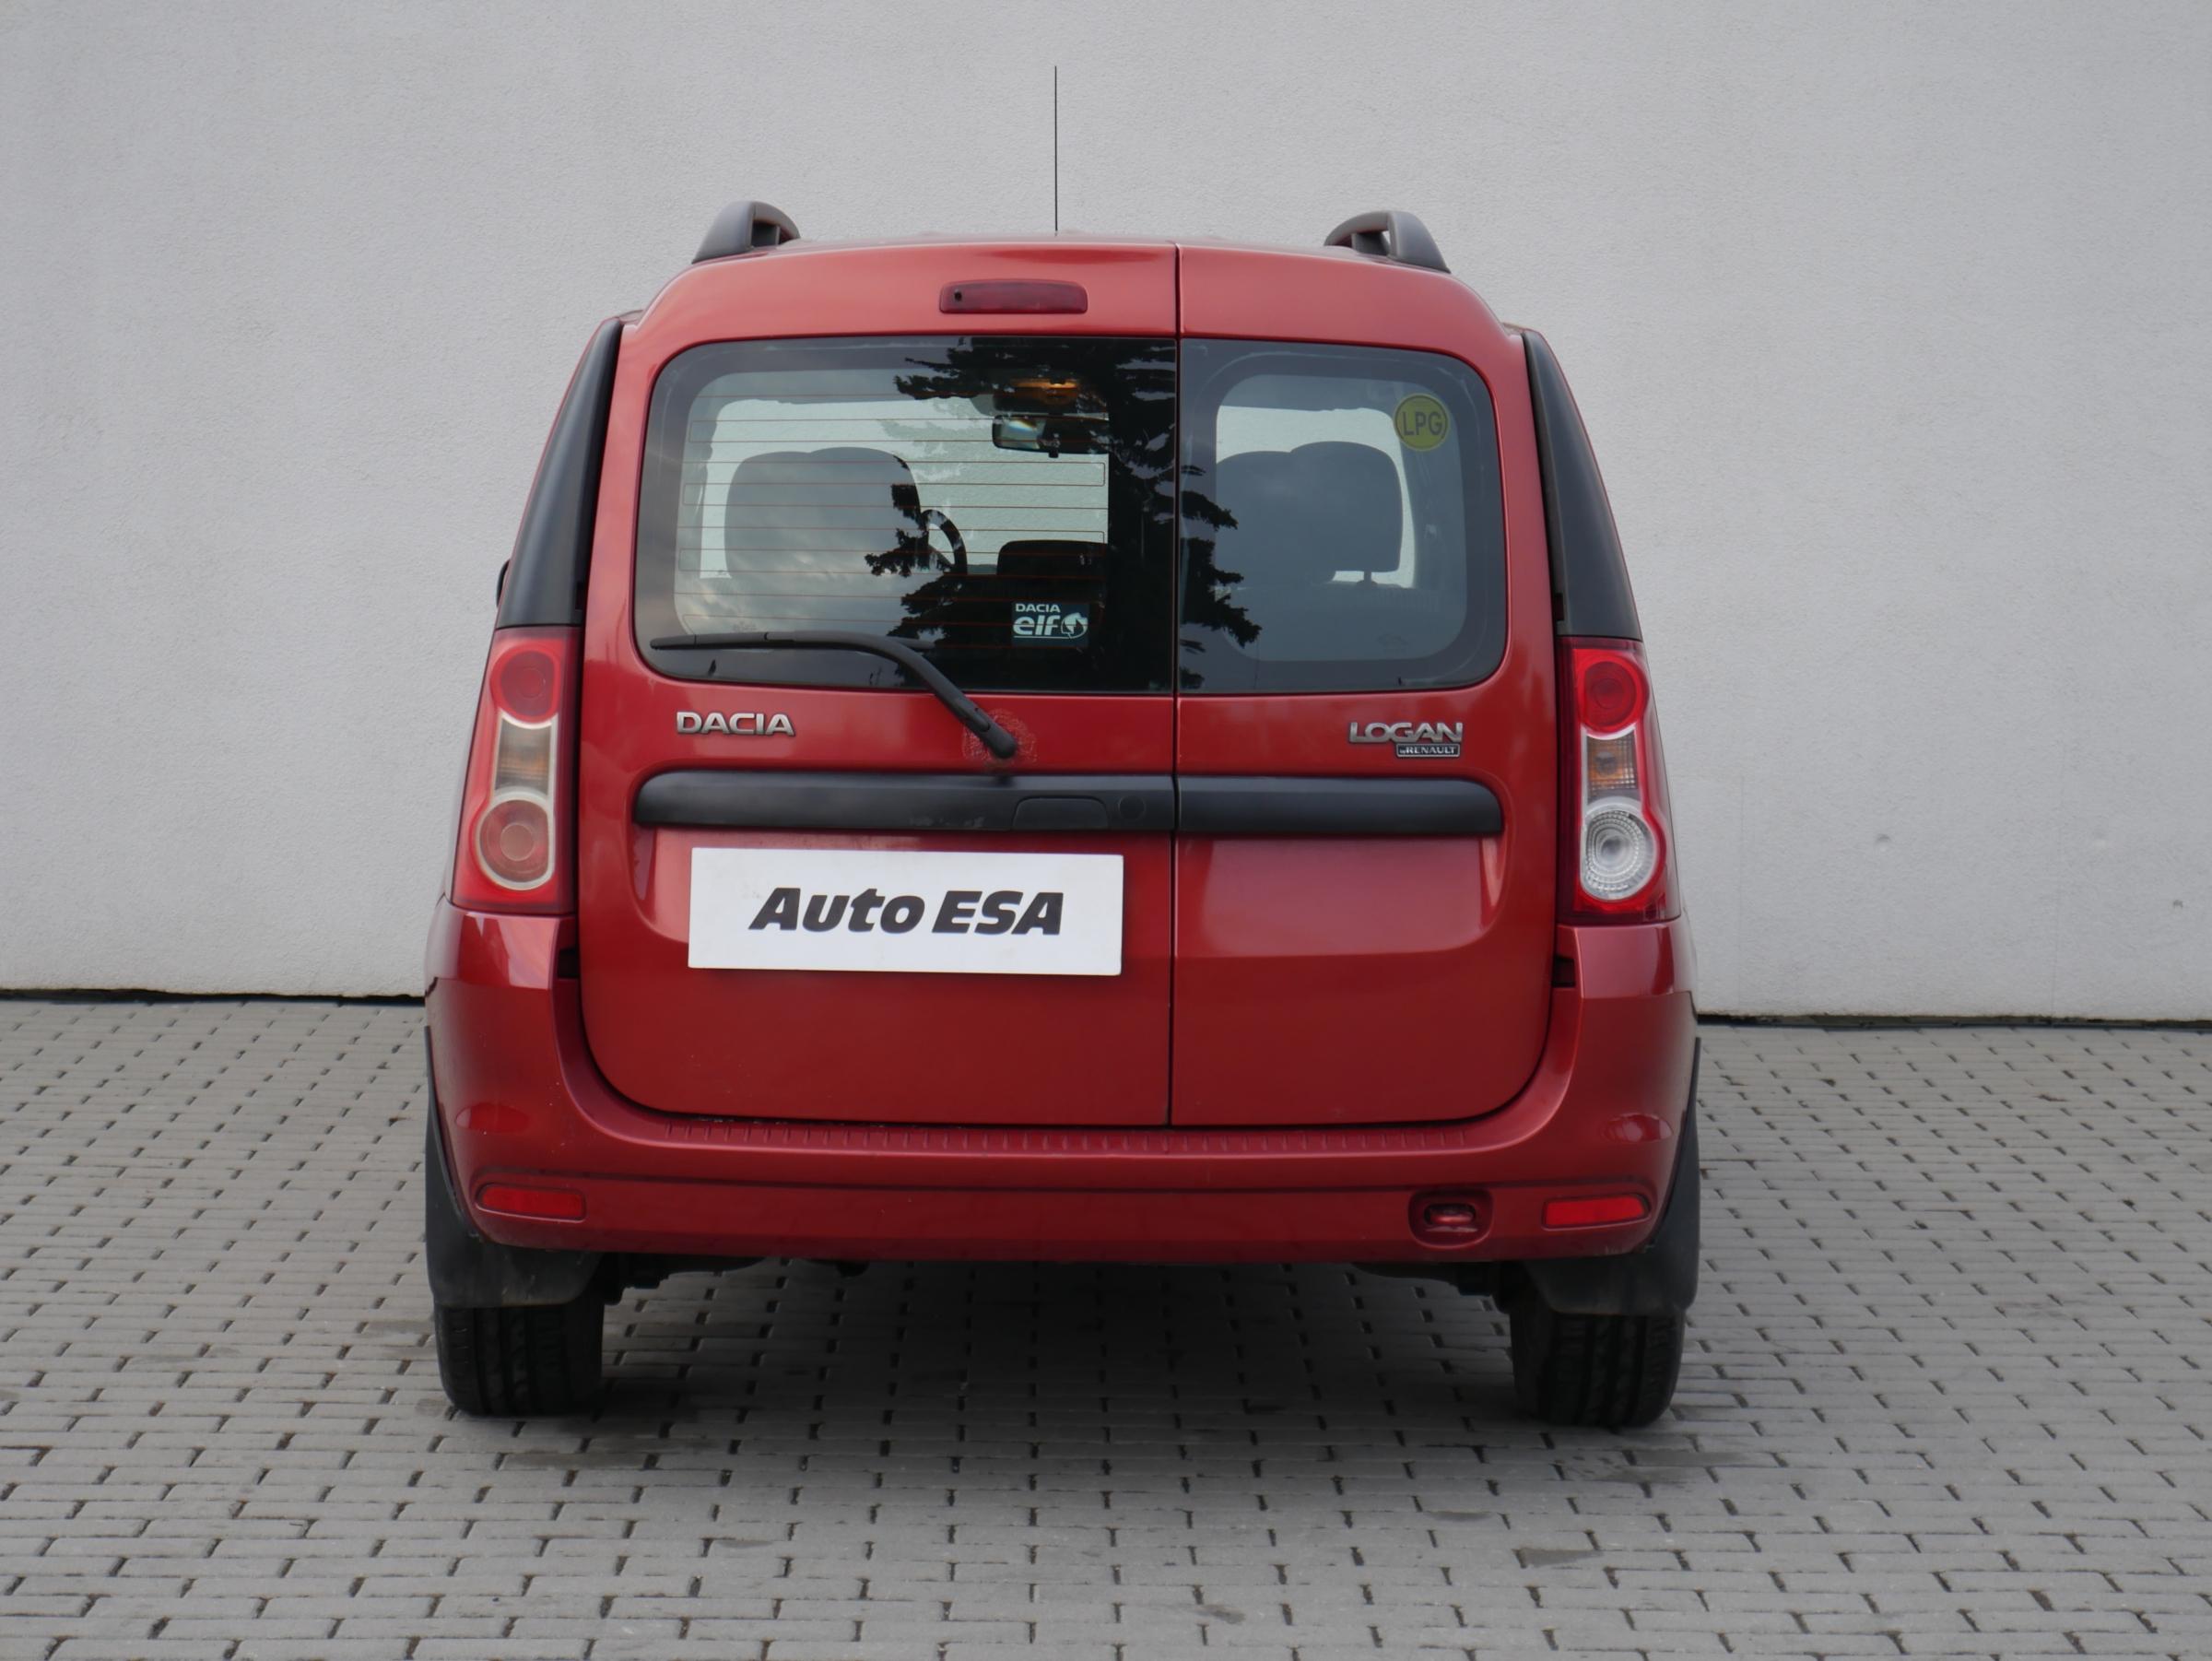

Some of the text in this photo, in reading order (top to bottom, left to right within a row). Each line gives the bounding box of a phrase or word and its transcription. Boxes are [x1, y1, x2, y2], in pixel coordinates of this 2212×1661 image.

[1402, 410, 1443, 436] LPG
[1015, 603, 1062, 613] DACIA
[1012, 614, 1062, 636] elf
[676, 711, 795, 736] DACIA
[1348, 722, 1464, 743] LOGAN
[747, 887, 1065, 936] Auto ESA
